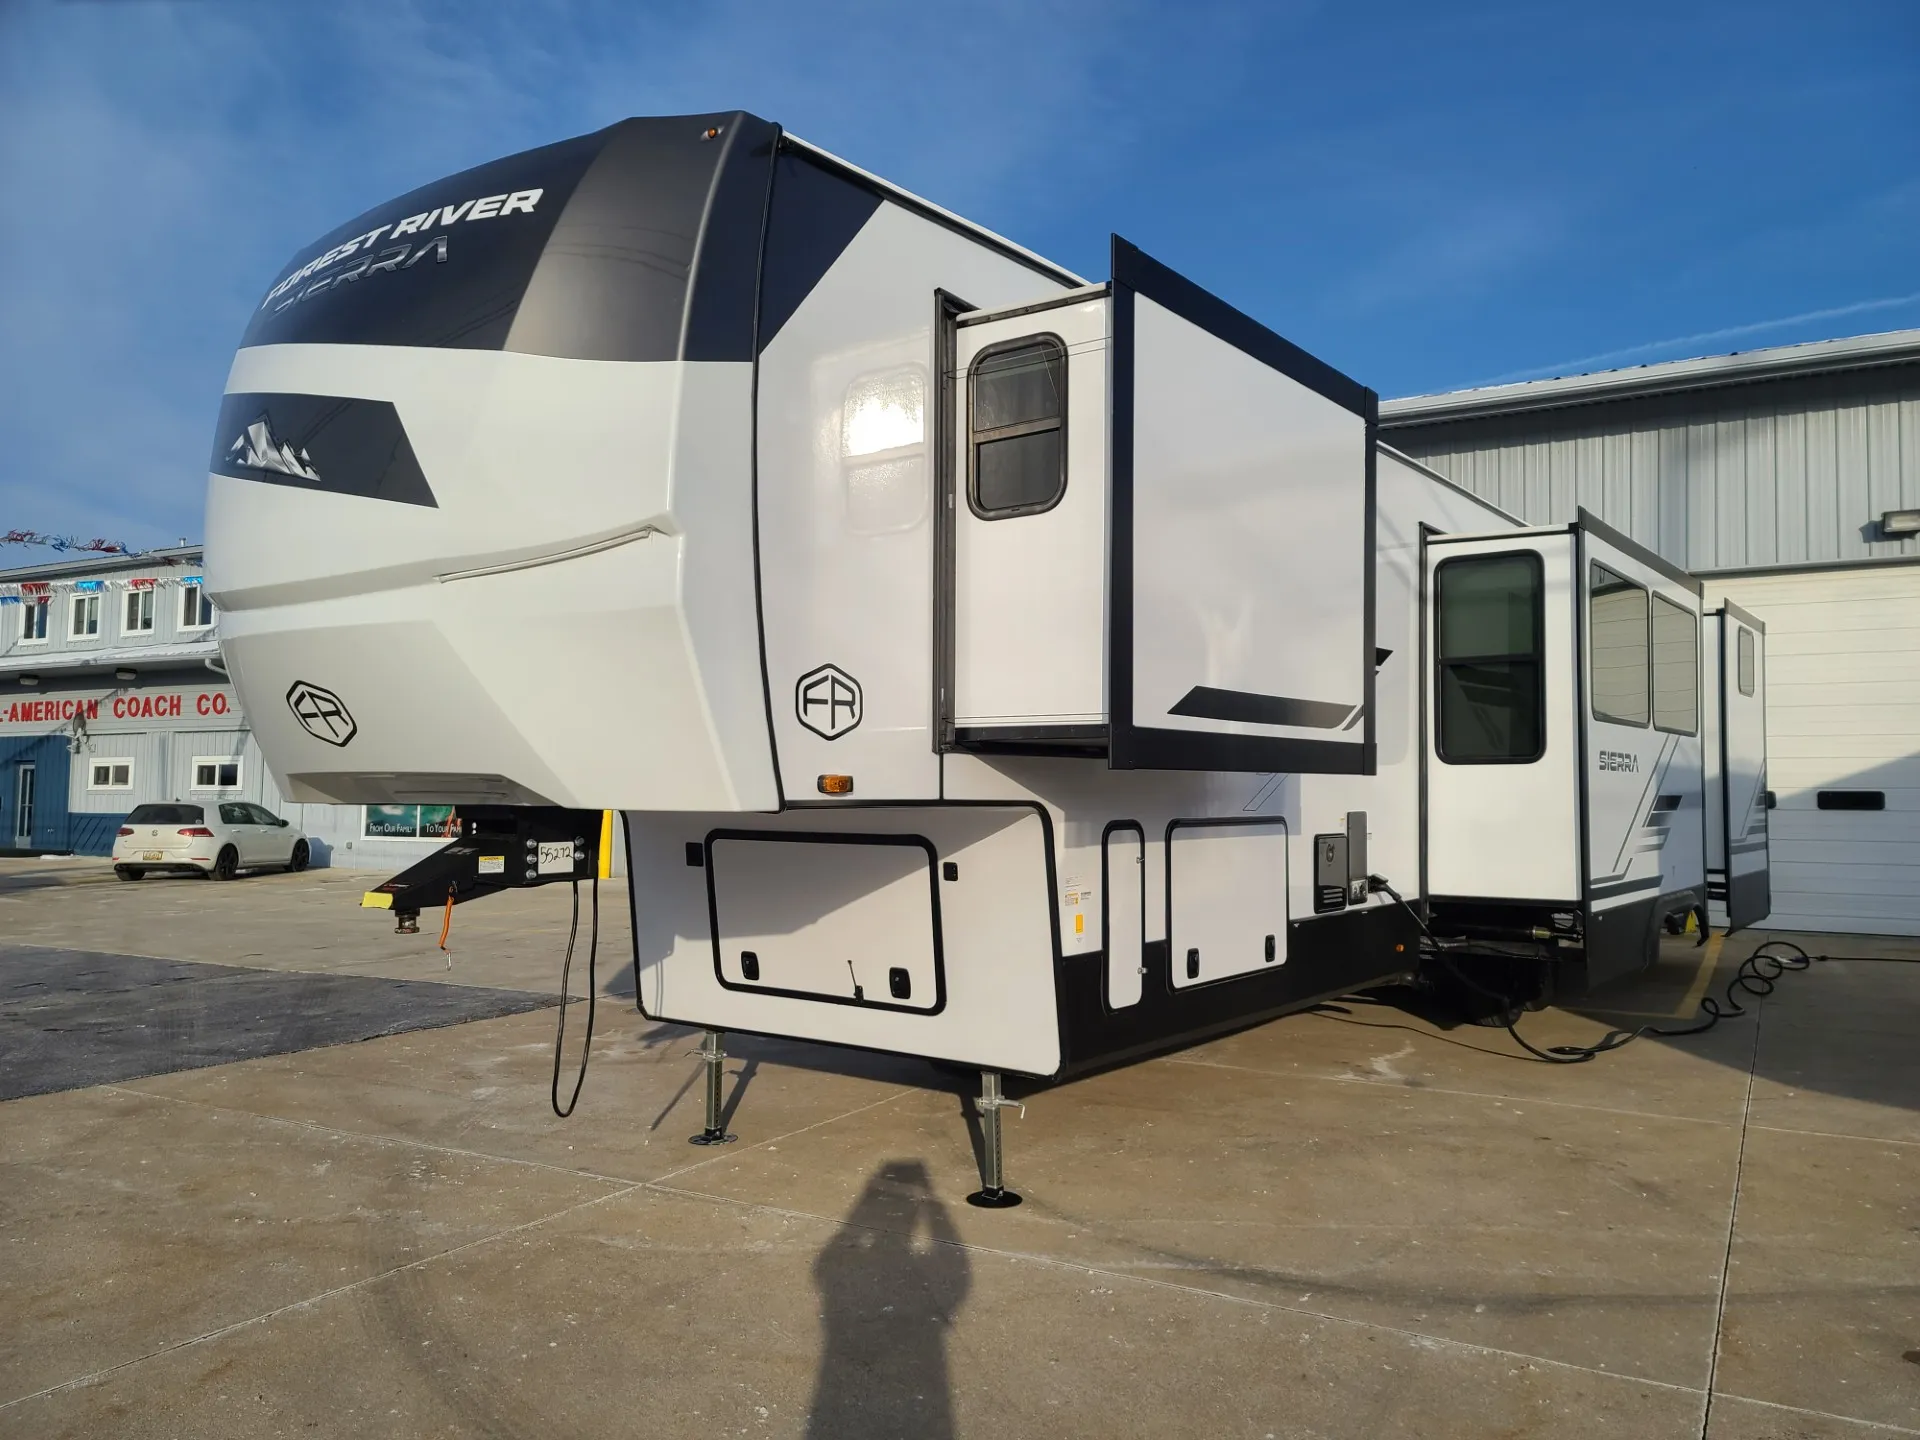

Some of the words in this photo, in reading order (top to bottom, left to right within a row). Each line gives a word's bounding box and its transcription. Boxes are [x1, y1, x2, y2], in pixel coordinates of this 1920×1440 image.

[261, 224, 392, 311] FOREST
[390, 188, 544, 240] RIVER
[271, 235, 448, 317] SIERRA
[0, 698, 98, 723] -AMERICAN
[113, 695, 181, 719] COACH
[196, 693, 231, 716] CO.
[1599, 750, 1639, 773] SIERRA
[540, 846, 574, 864] 55272
